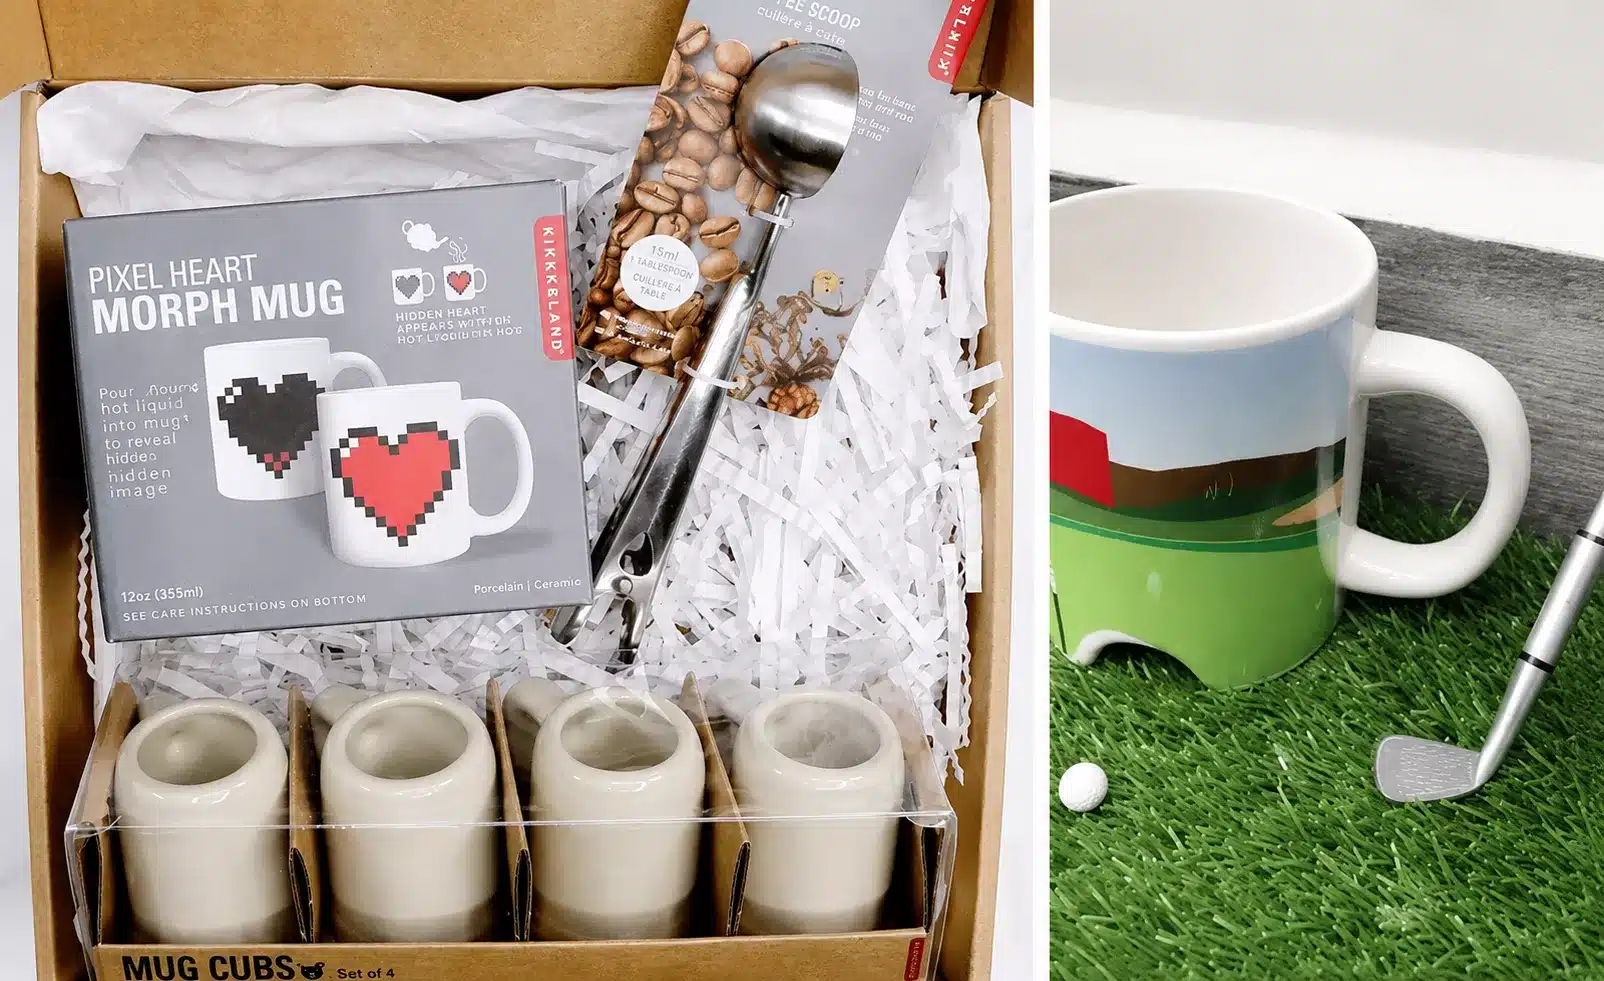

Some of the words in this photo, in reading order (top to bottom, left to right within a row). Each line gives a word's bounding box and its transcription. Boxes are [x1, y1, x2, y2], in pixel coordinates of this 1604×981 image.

[808, 1, 861, 30] SCOOP
[88, 262, 163, 294] PIXEL
[169, 253, 258, 288] HEART
[637, 257, 694, 280] TABLESPOON
[640, 286, 667, 301] TABLE
[91, 287, 239, 335] MORPH
[250, 279, 345, 321] MUG
[395, 309, 443, 322] HIDDEN
[447, 305, 487, 318] HEART
[397, 320, 454, 334] APPEARS
[99, 387, 134, 399] Pour
[101, 402, 129, 415] hot
[135, 397, 183, 415] liquid
[103, 419, 136, 432] into
[104, 438, 121, 450] to
[127, 431, 177, 448] reveal
[109, 484, 168, 499] image
[120, 591, 151, 603] 12oz
[154, 586, 204, 602] (355ml)
[473, 581, 524, 594] Porcelain
[123, 612, 146, 622] SEE
[151, 608, 186, 620] CARE
[190, 600, 286, 616] INSTRUCTIONS
[290, 599, 309, 608] ON
[314, 594, 367, 607] BOTTOM
[121, 955, 199, 981] MUG
[208, 955, 296, 981] CUBS
[336, 968, 363, 979] Set
[367, 968, 382, 979] of
[386, 968, 395, 978] 4
